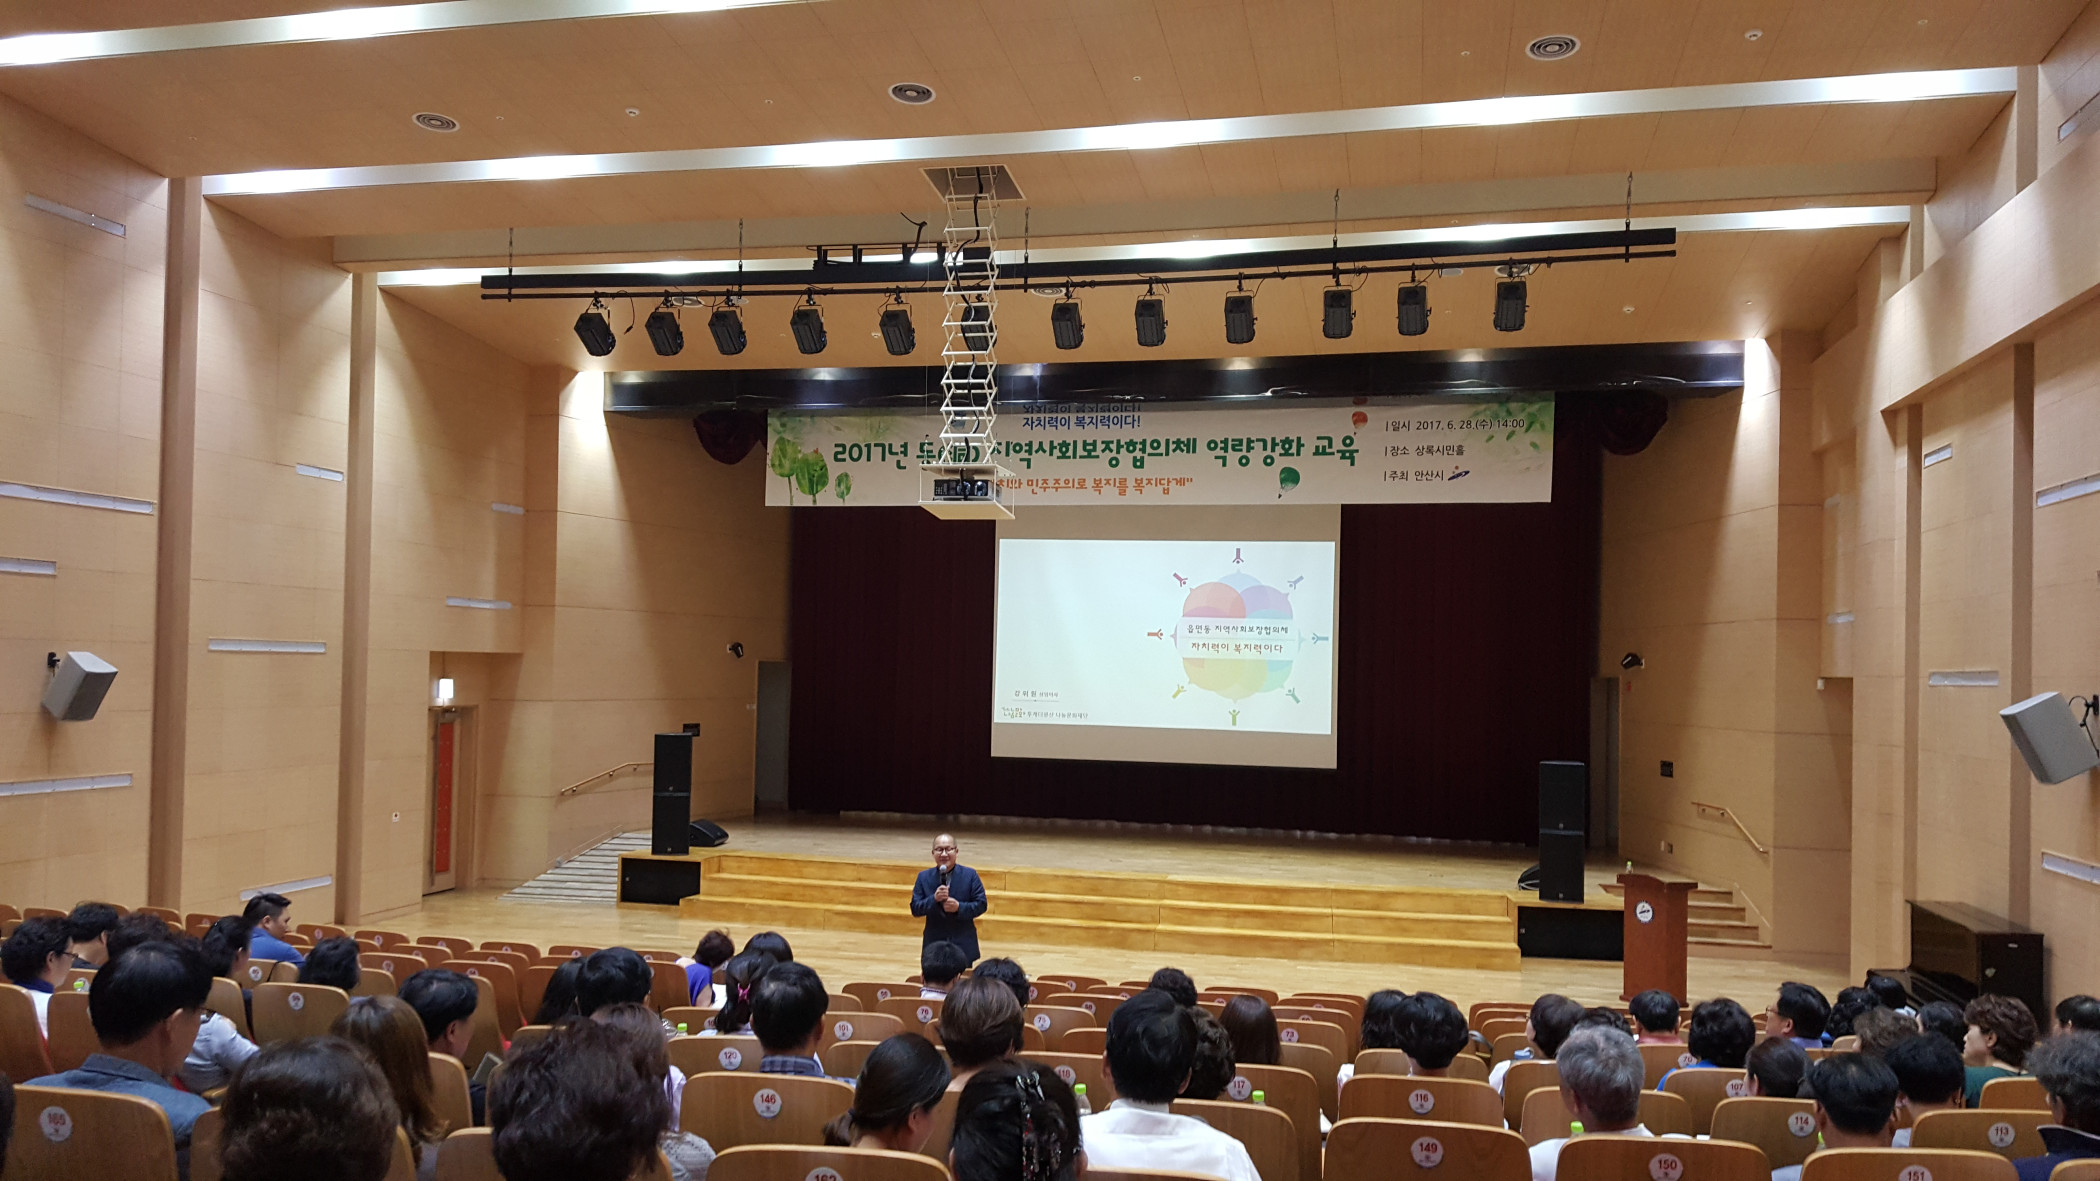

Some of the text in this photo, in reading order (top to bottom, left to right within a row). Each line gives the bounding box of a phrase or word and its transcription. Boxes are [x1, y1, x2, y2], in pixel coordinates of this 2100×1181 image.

[1022, 414, 1141, 430] 자치력이 복지력이다!
[1391, 420, 1410, 431] 일시
[1497, 418, 1525, 429] 14:00
[833, 441, 909, 470] 2017년
[990, 437, 1198, 470] 지역사회보장협의체
[1206, 436, 1306, 468] 역량강화
[1312, 434, 1360, 467] 교육
[1390, 444, 1466, 456] 장소 상록시민홀
[1388, 469, 1444, 481] 주최 안산시
[1026, 477, 1088, 495] 민주주의로
[1091, 477, 1129, 496] 복지를
[1215, 624, 1289, 636] 지역사회보장협의체
[1191, 642, 1283, 655] 자치력이 복지력이다
[838, 1024, 849, 1032] 101
[1233, 1080, 1246, 1089] 117
[1730, 1083, 1744, 1091] 107
[760, 1093, 777, 1104] 146
[1795, 1115, 1809, 1125] 114
[1995, 1126, 2009, 1136] 113
[1419, 1142, 1438, 1153] 149
[1657, 1159, 1678, 1170] 150
[1907, 1170, 1925, 1181] 151
